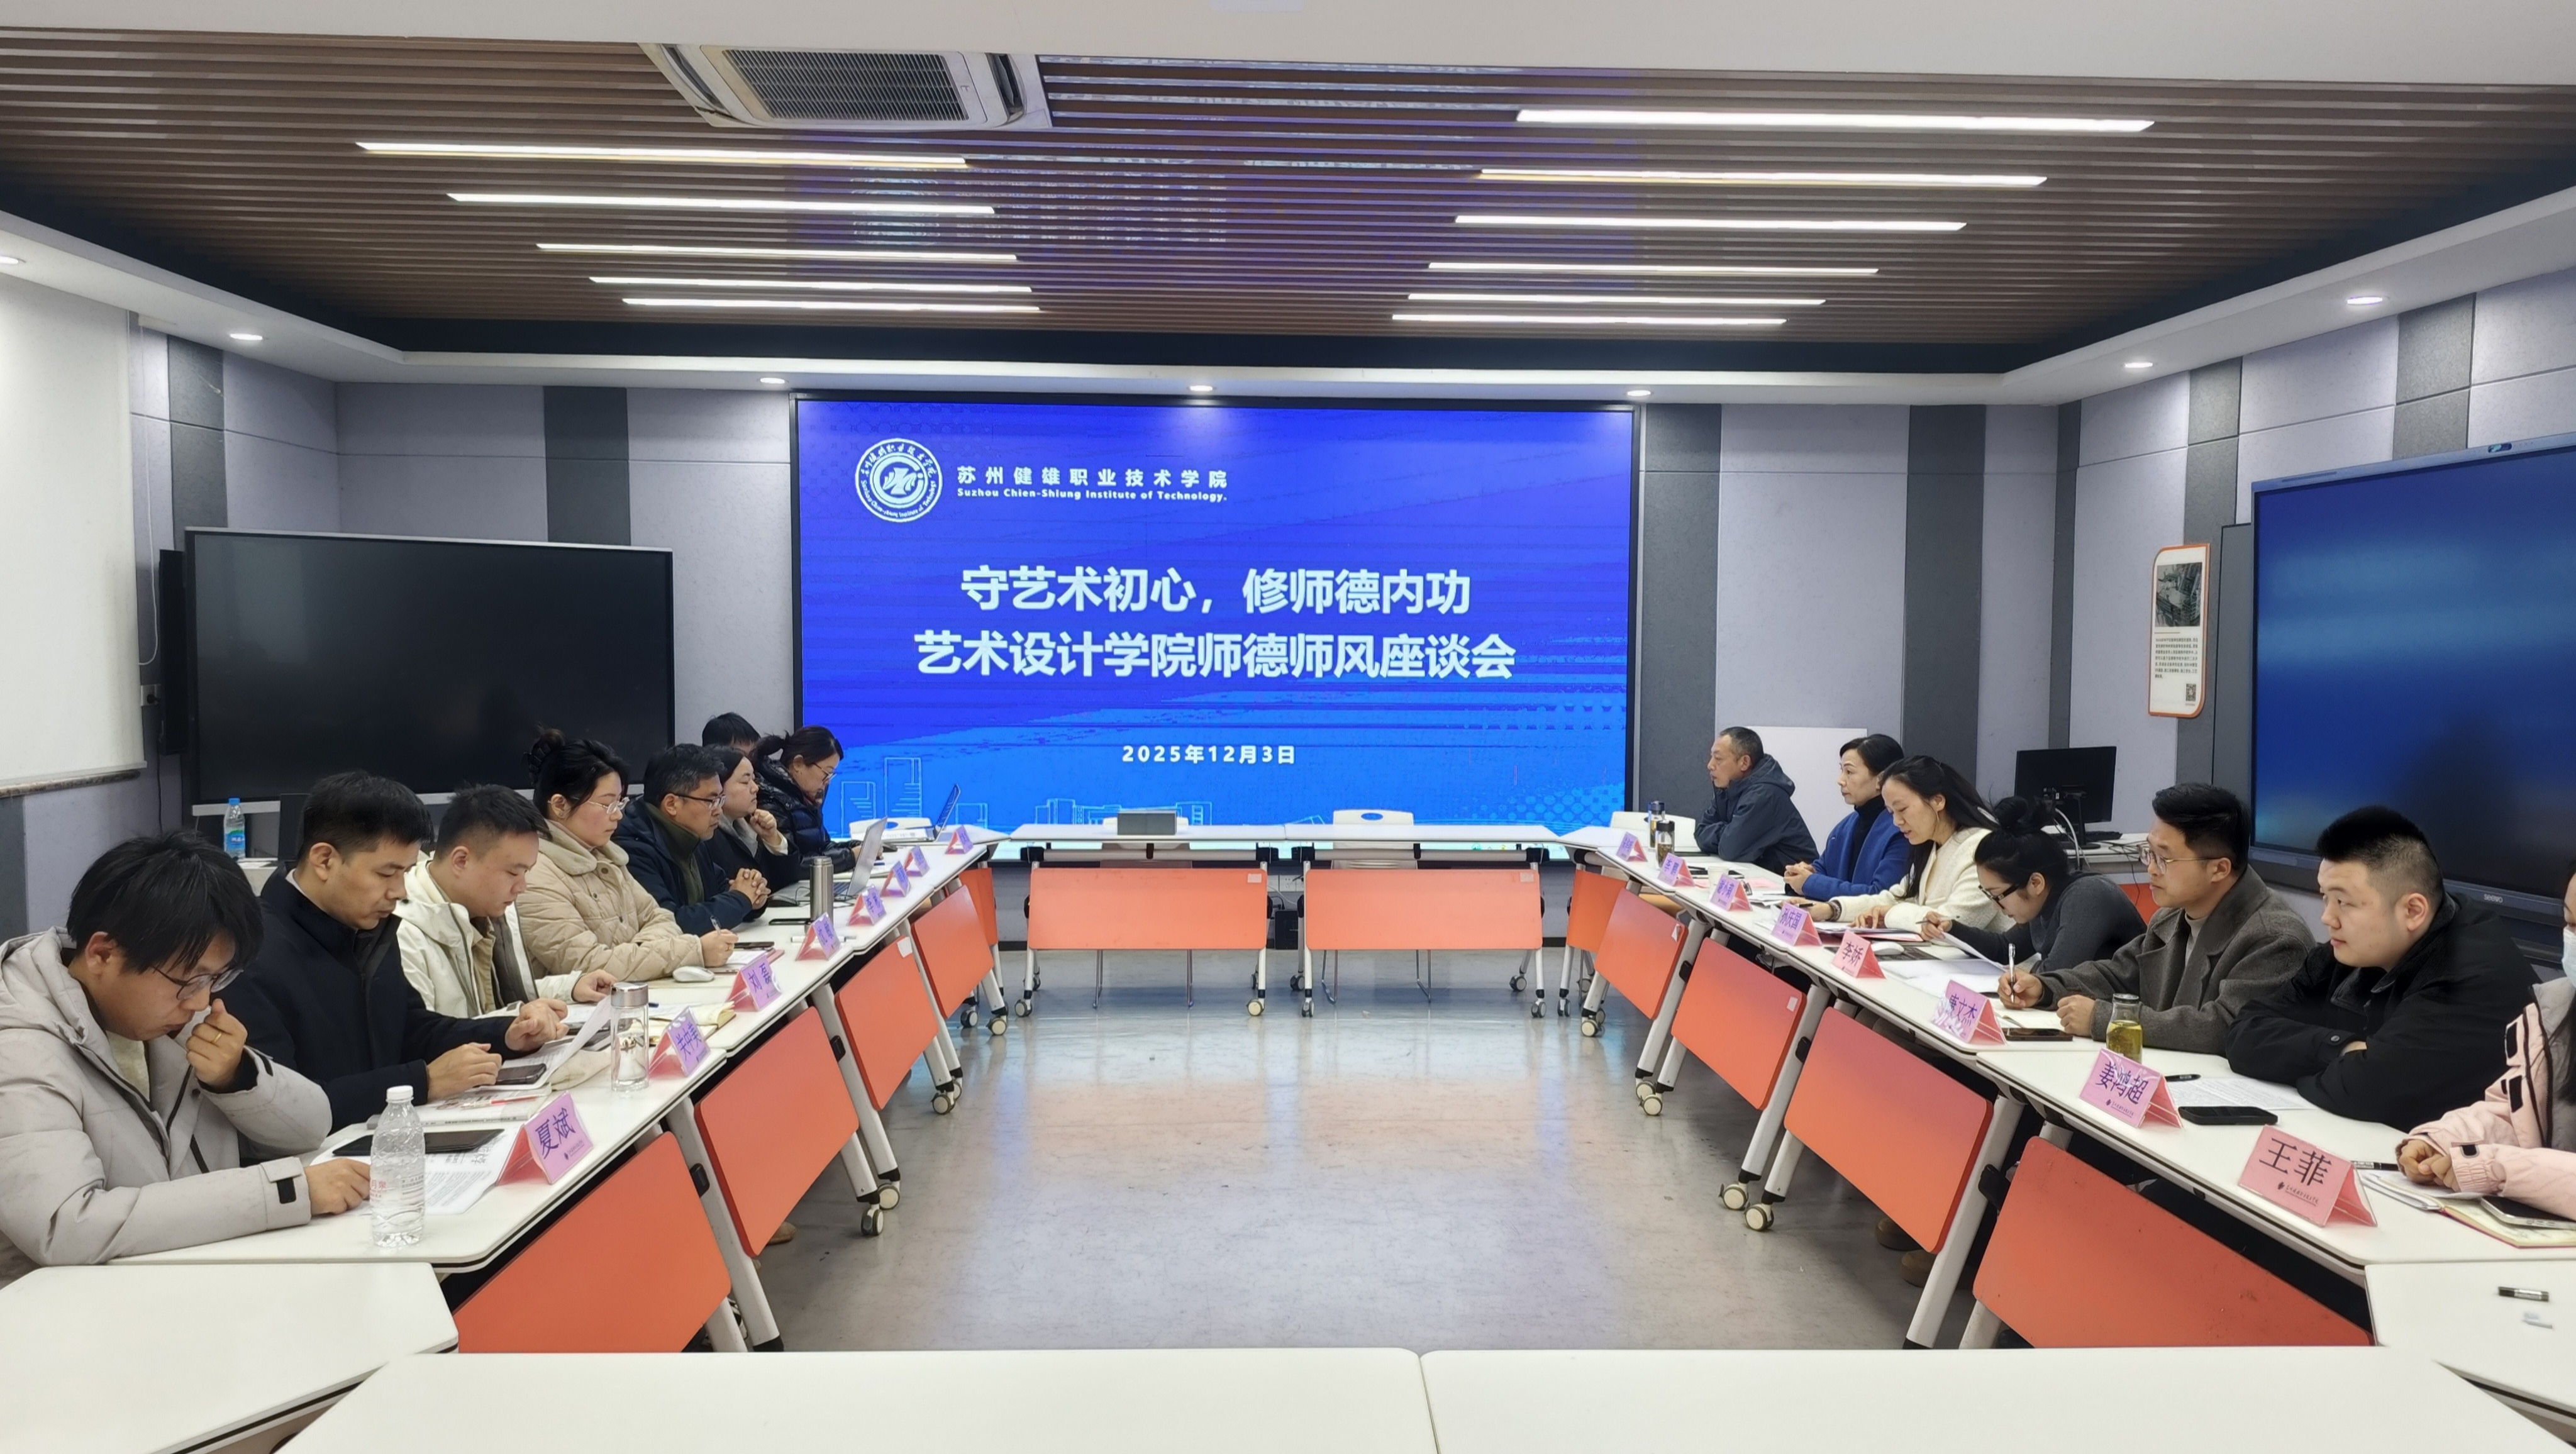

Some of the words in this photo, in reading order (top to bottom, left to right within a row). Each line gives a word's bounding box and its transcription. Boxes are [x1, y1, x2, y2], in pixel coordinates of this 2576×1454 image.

[957, 466, 1228, 489] 苏州健雄职业技术学院
[957, 488, 999, 497] Suzhou
[1003, 489, 1082, 501] Chien-Shiung
[1085, 490, 1137, 500] Institute
[1140, 491, 1153, 500] of
[1157, 491, 1228, 503] Technology.
[960, 565, 1471, 615] 守艺术初心，修师德内功
[914, 630, 1516, 680] 艺术设计学院师德师风座谈会
[1123, 745, 1295, 765] 2025年12月3日
[1779, 907, 1802, 930] 孙庆国
[748, 962, 772, 994] 刘磊
[2094, 1060, 2149, 1105] 姜鸿超
[535, 1107, 576, 1160] 夏斌
[2258, 1137, 2333, 1186] 王菲
